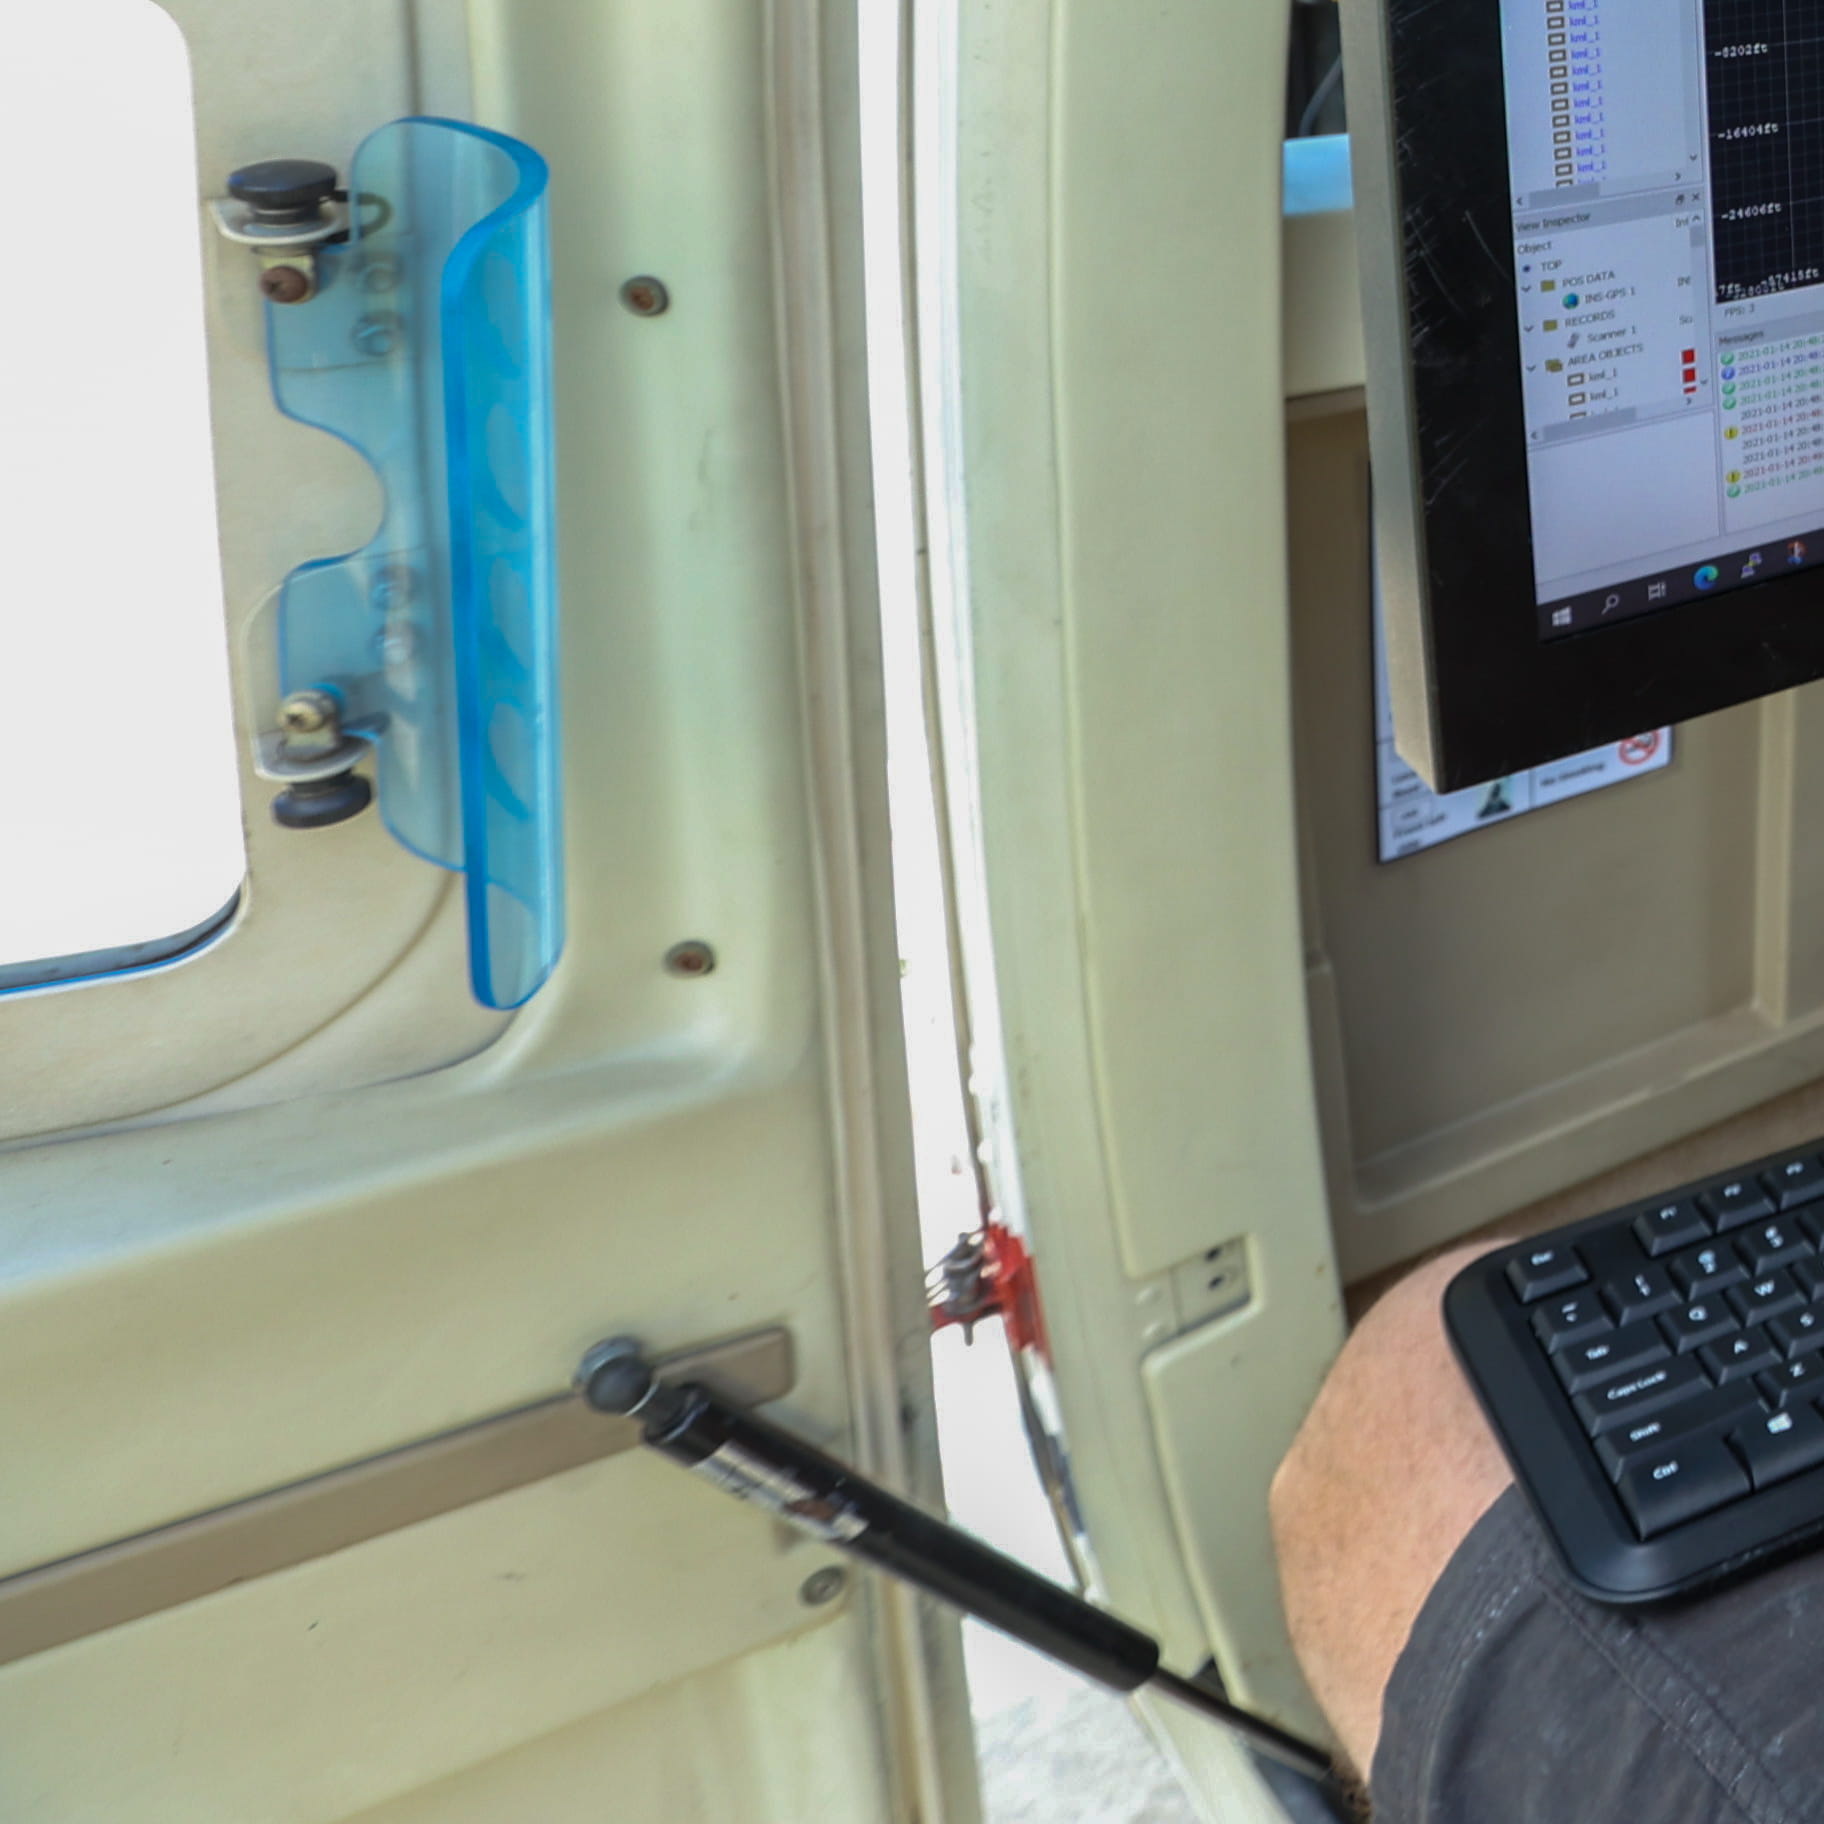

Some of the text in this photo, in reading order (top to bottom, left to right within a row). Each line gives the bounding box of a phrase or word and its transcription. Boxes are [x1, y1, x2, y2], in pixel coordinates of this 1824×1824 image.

[1542, 212, 1591, 228] Inspector
[1517, 240, 1552, 255] Object
[1541, 259, 1562, 272] TOP
[1562, 270, 1616, 288] POS DATA
[1584, 289, 1627, 305] INS-GPS
[1565, 309, 1616, 328] RECORDS
[1724, 305, 1746, 318] FPS:
[1586, 329, 1627, 344] Scanner
[1719, 329, 1765, 346] Messages
[1567, 353, 1597, 367] AREA
[1738, 342, 1790, 361] 2021-01-14
[1739, 357, 1790, 376] 2021-01-14
[1740, 372, 1791, 391] 2021-01-14
[1741, 387, 1791, 406] 2021-01-14
[1742, 401, 1793, 421] 2021-01-14
[1742, 416, 1793, 435] 2021-01-14
[1743, 430, 1794, 450] 2021-01-14
[1743, 444, 1795, 464] 2021-01-14
[1744, 459, 1795, 479] 2021-01-14
[1744, 474, 1795, 494] 2021-01-14
[1754, 1280, 1775, 1296] W
[1607, 1382, 1637, 1400] Caps
[1629, 1422, 1661, 1441] Shift
[1653, 1460, 1679, 1480] Ctrl
